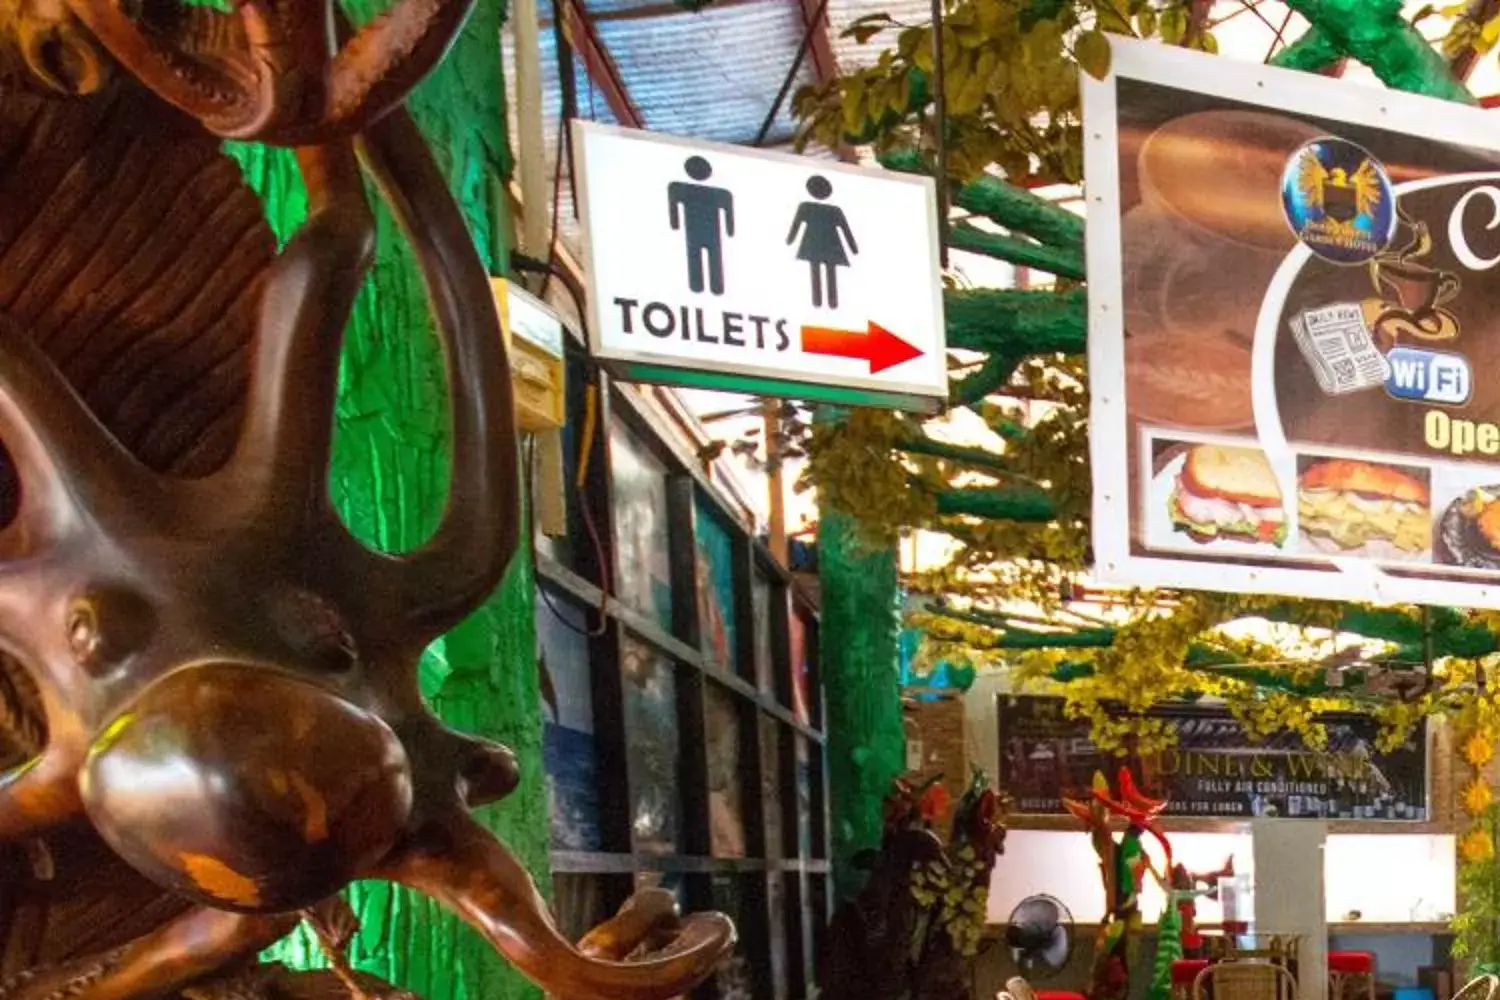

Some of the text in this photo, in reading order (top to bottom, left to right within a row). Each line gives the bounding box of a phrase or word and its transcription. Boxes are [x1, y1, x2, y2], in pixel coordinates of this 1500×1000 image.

[613, 297, 790, 352] TOILETS
[1156, 749, 1242, 777] DINE
[1249, 752, 1273, 778] &
[1197, 779, 1230, 794] FULLY
